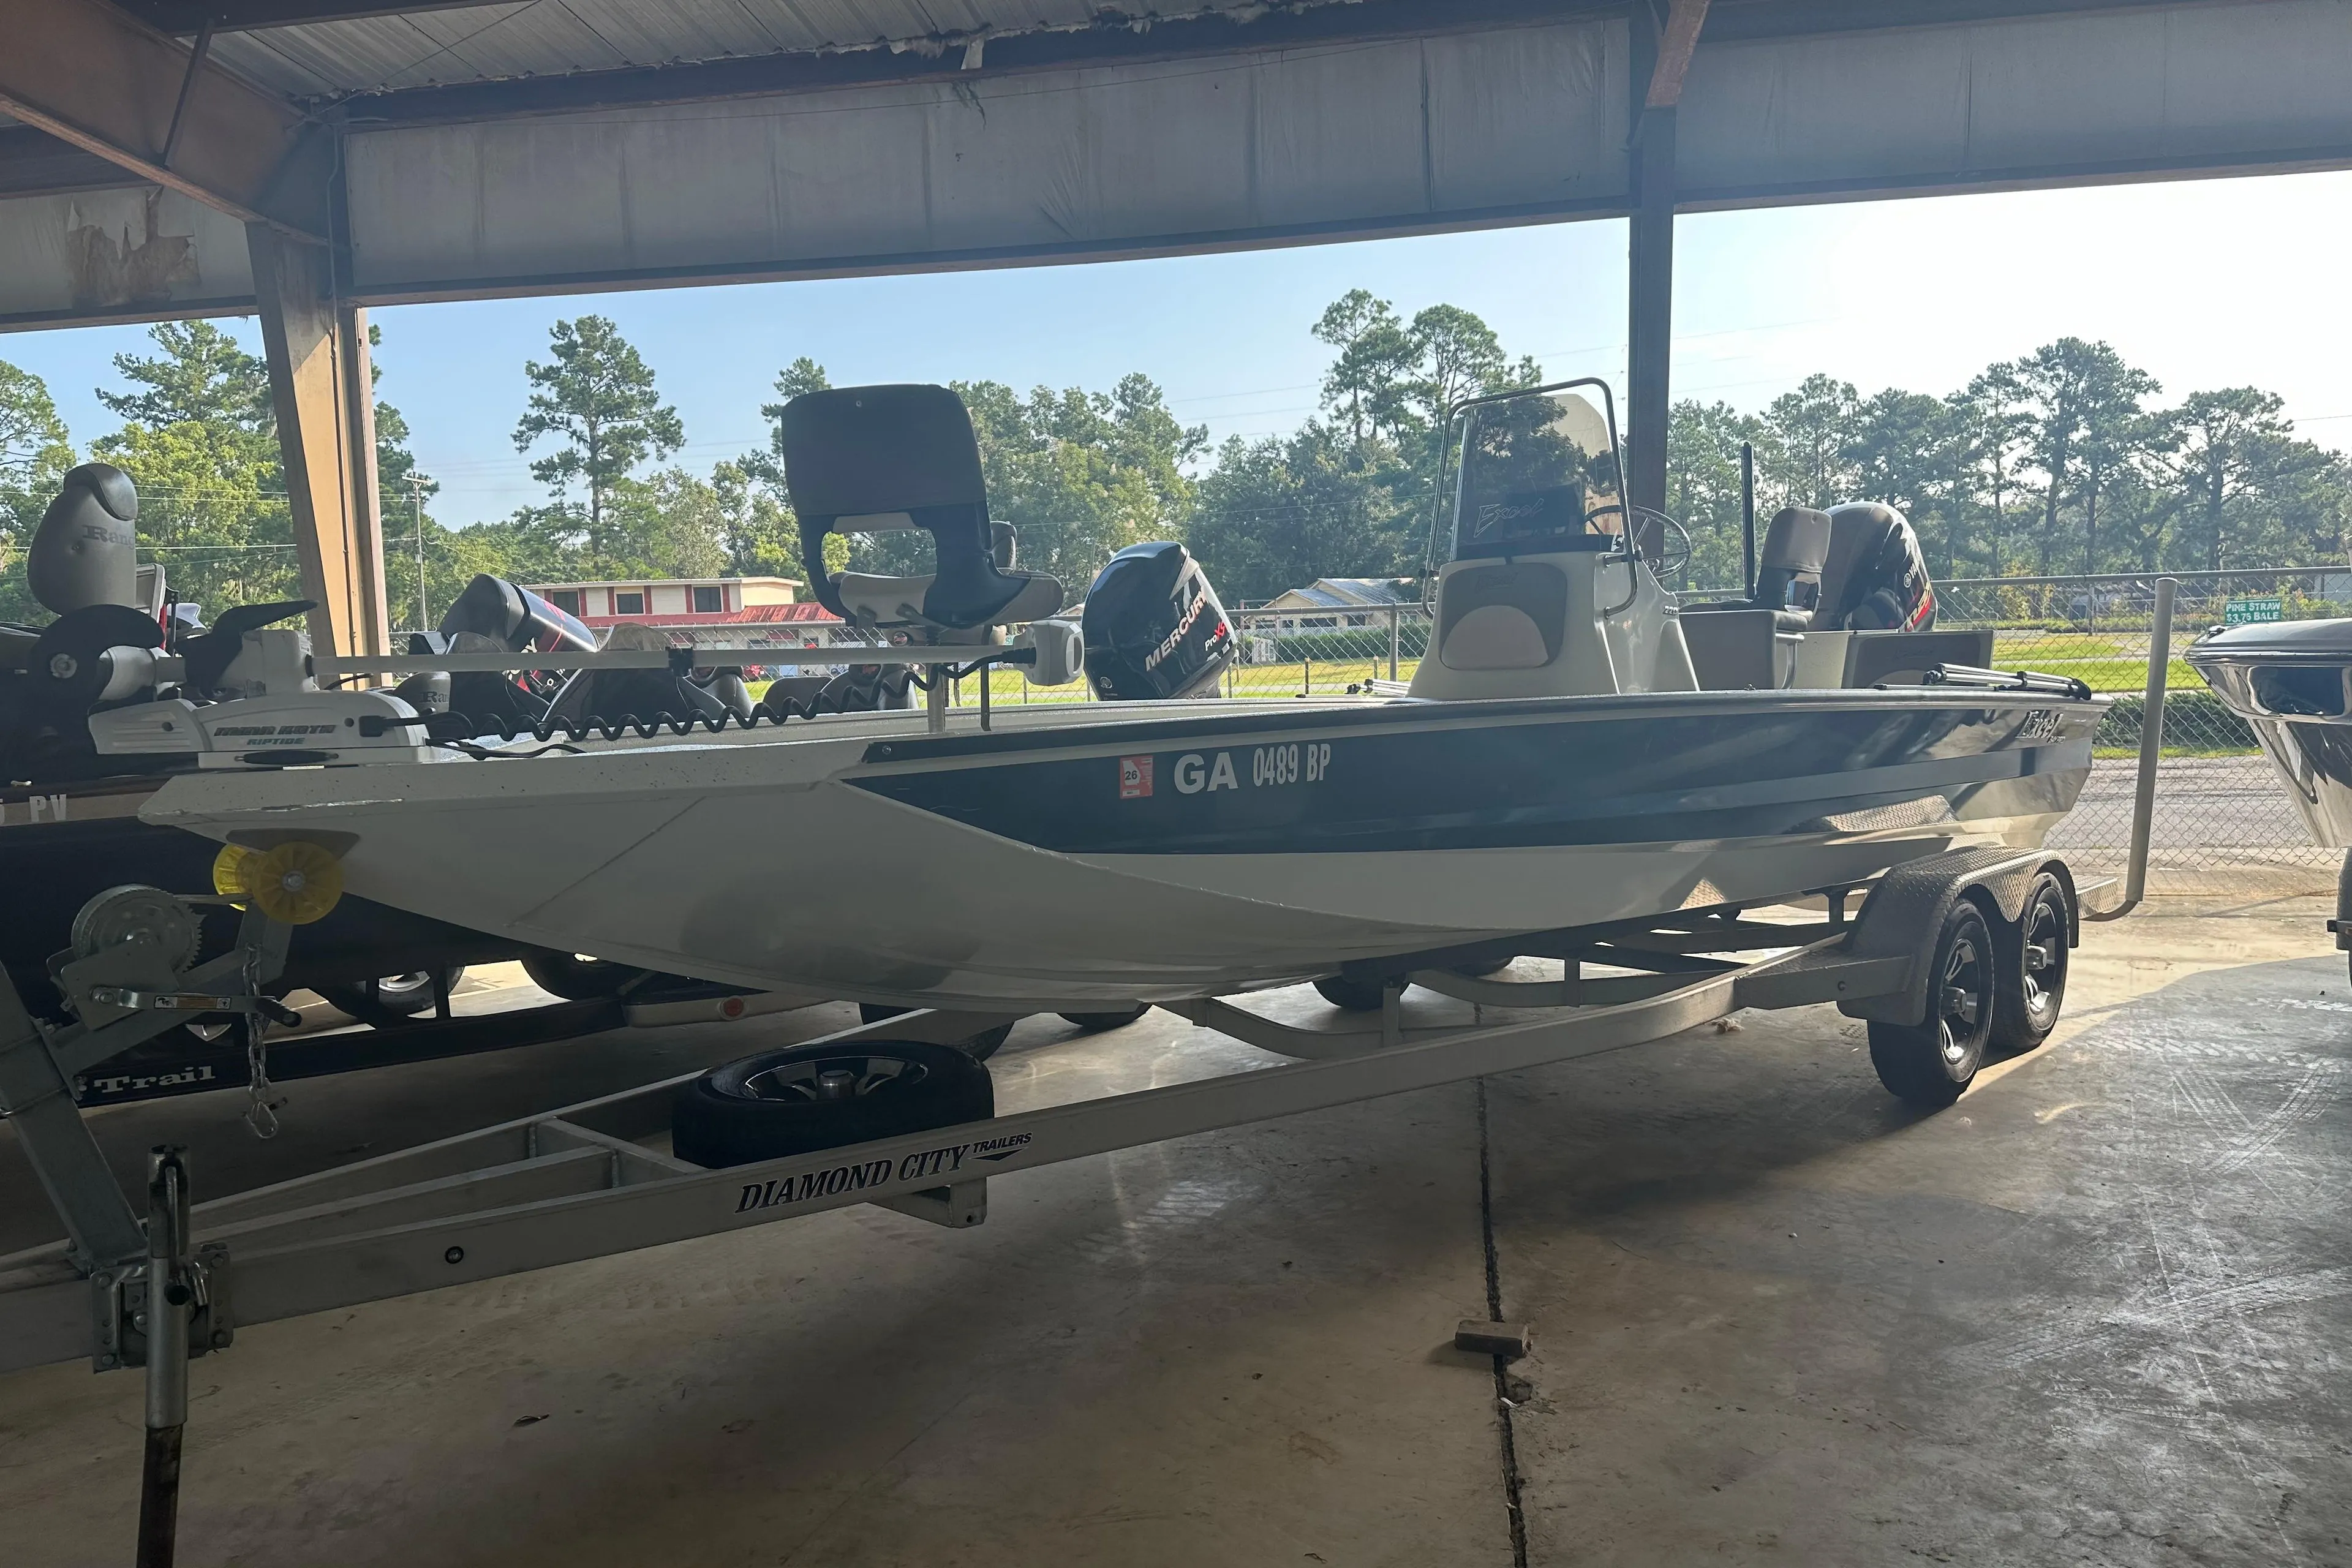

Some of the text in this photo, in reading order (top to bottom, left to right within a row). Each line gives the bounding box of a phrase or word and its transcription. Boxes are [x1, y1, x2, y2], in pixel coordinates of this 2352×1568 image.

[1474, 498, 1544, 538] Excel
[81, 524, 134, 550] Rang
[2226, 601, 2281, 612] PINE STRAW
[2253, 611, 2279, 620] BALE
[1145, 586, 1207, 671] MERCURY
[277, 725, 337, 736] KOTA
[1125, 770, 1137, 780] 26
[1174, 752, 1239, 794] GA
[1253, 744, 1298, 787] 0489
[1306, 743, 1331, 782] BP
[29, 794, 67, 822] PV
[93, 1066, 216, 1093] Trail
[734, 1132, 1033, 1215] DIAMOND CITY TRAILERS
